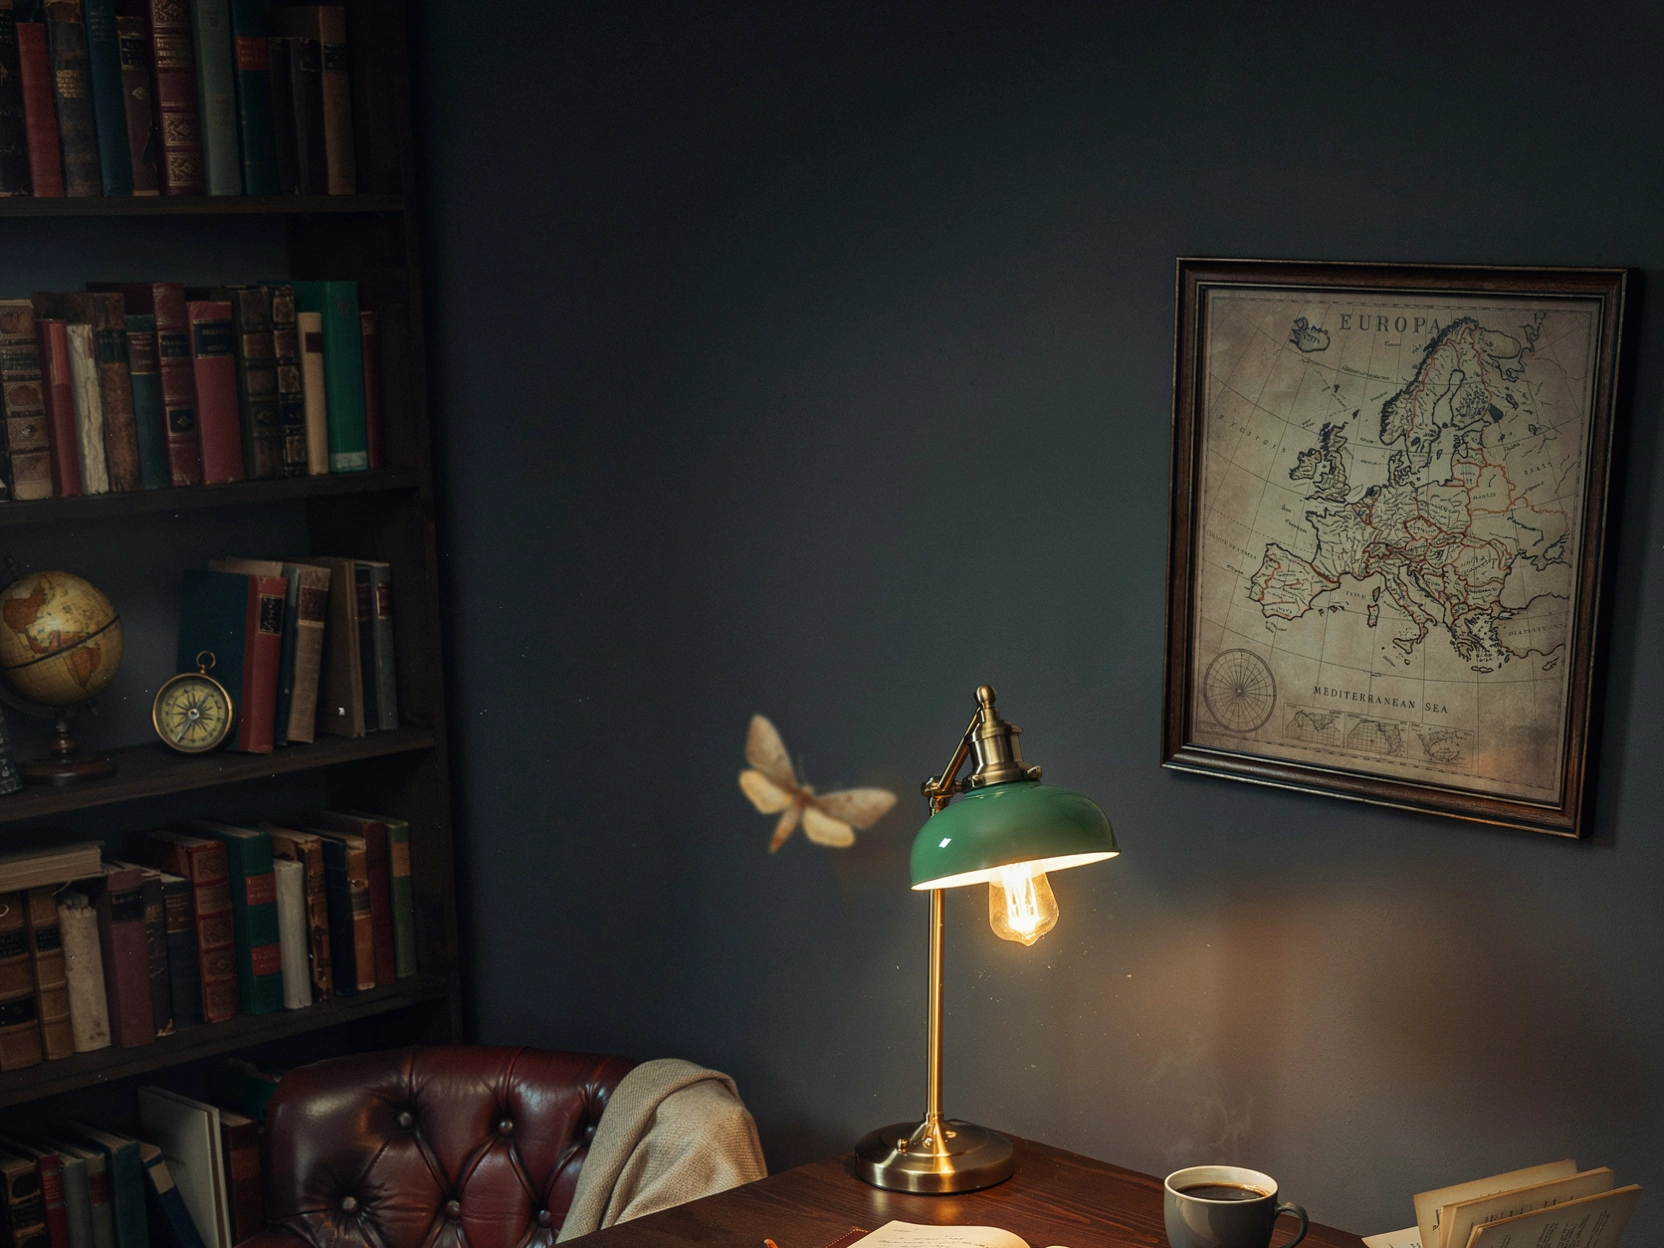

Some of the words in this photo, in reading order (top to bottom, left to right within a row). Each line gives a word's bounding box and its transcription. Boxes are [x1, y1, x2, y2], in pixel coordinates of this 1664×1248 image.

[1339, 313, 1443, 334] EUROPA
[1313, 686, 1415, 708] MEDITERRANEAN
[1425, 703, 1448, 714] SEA
